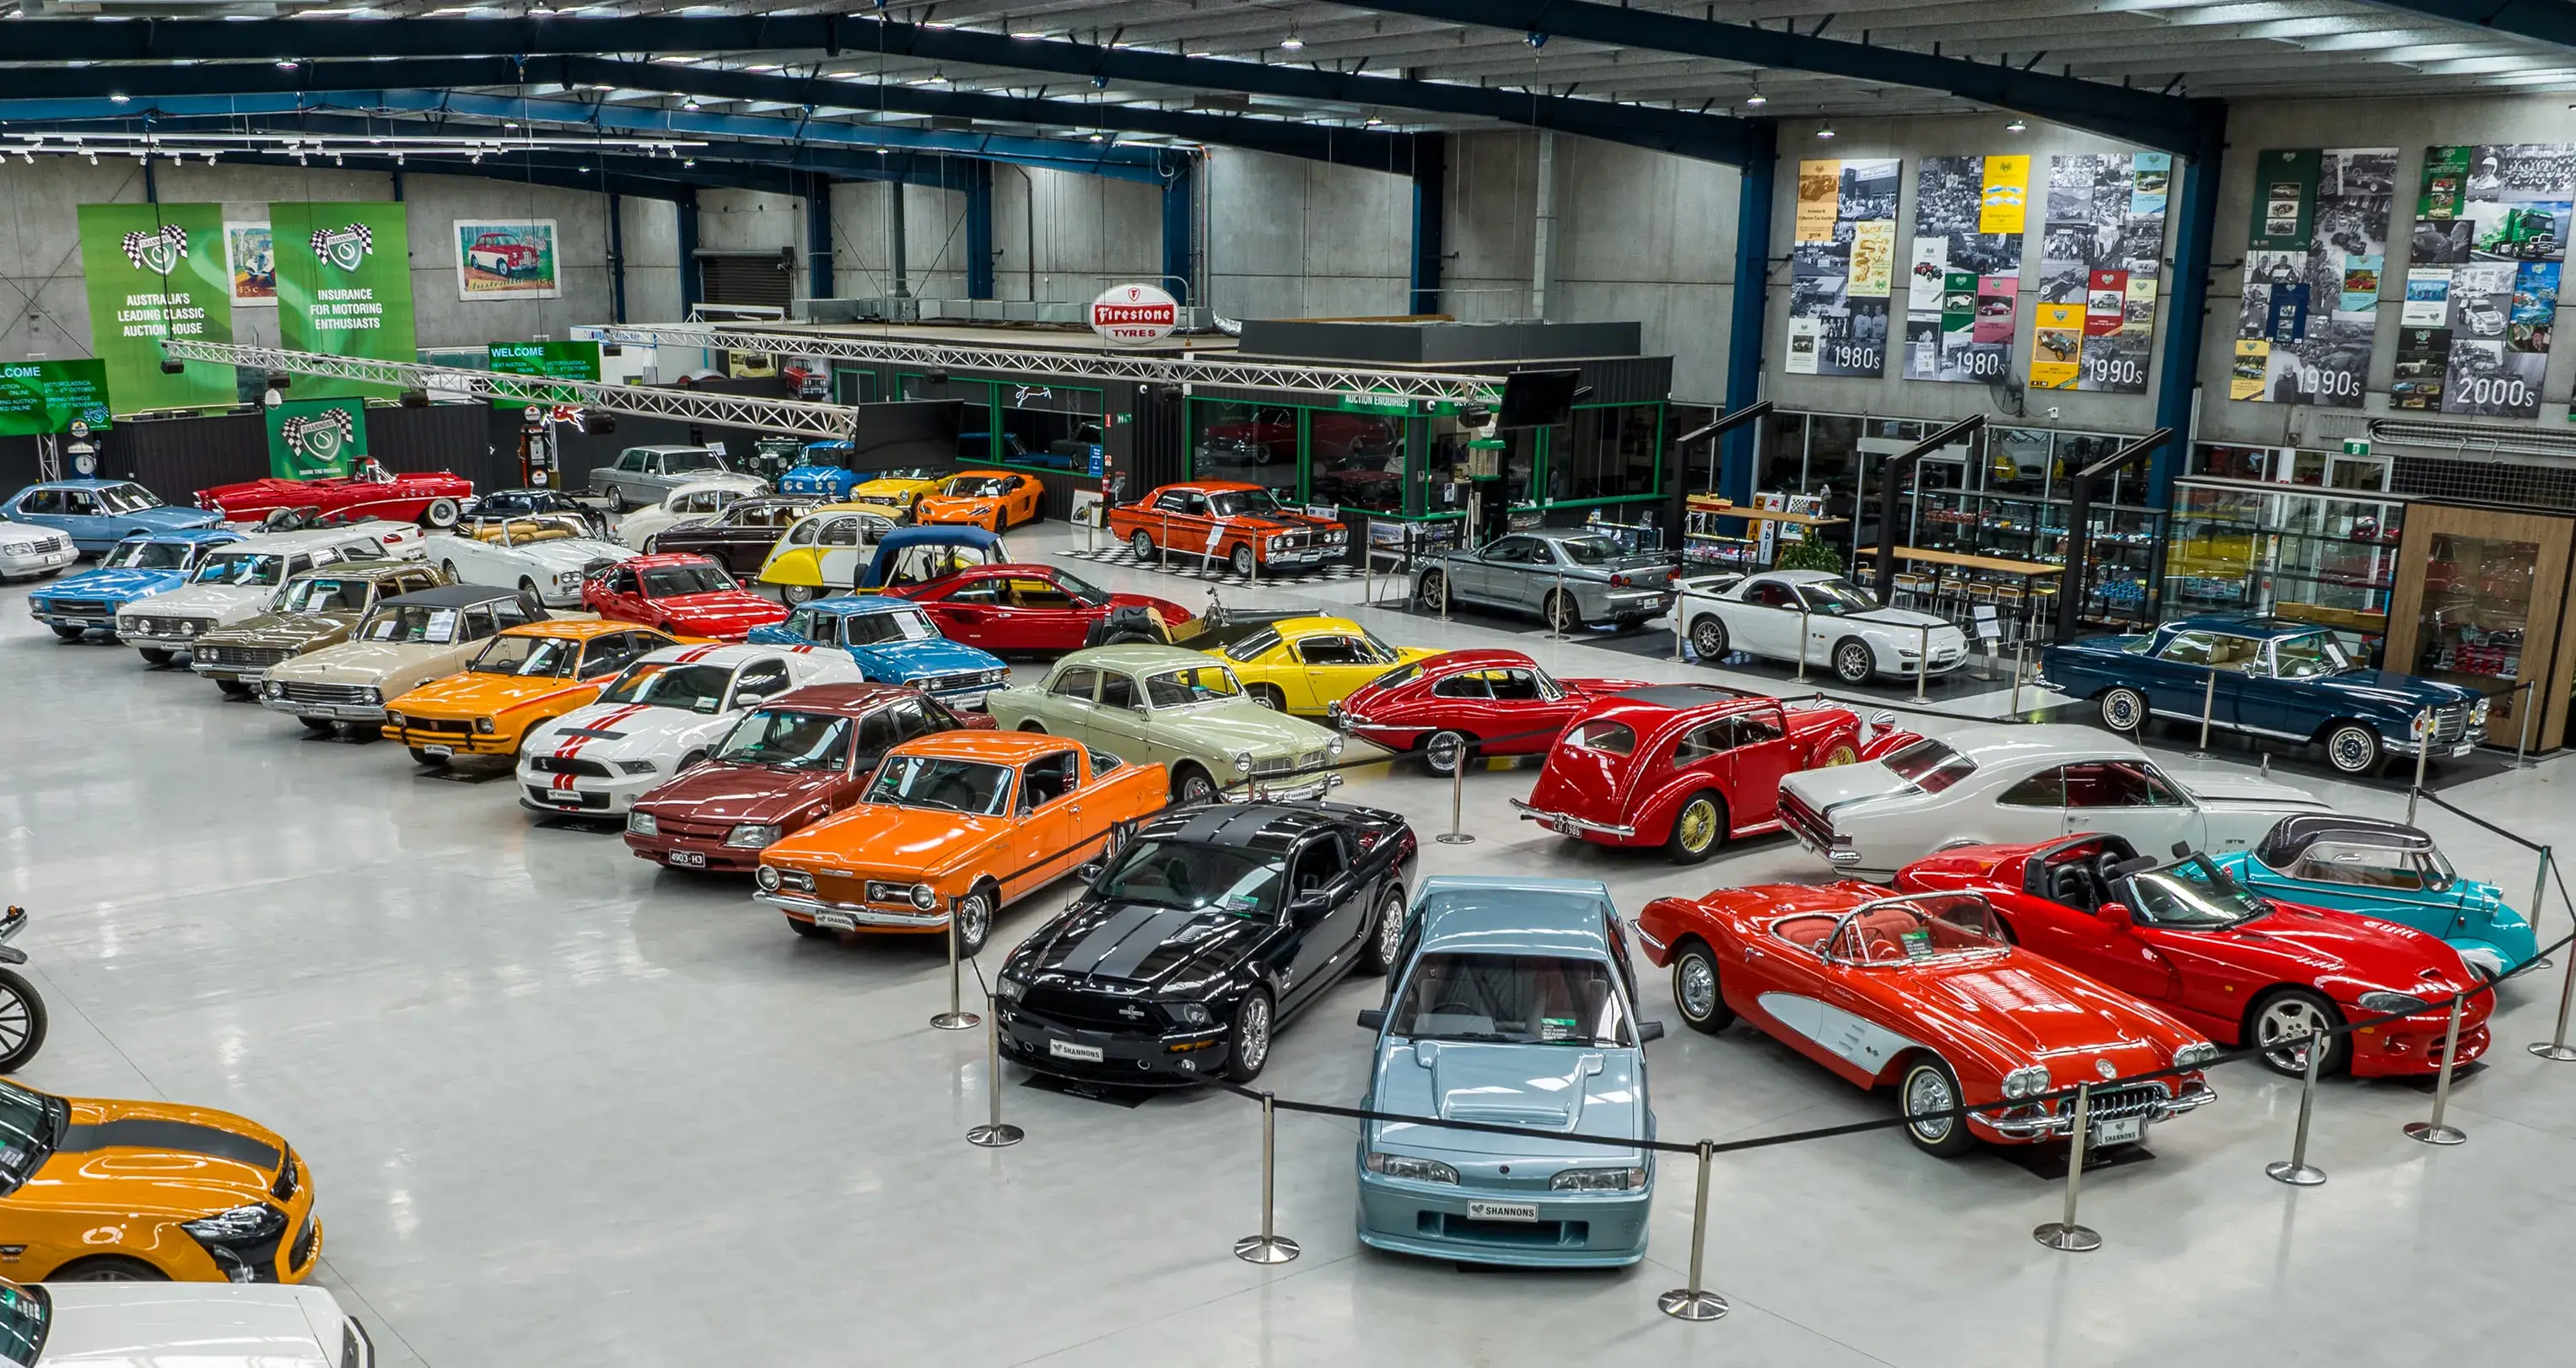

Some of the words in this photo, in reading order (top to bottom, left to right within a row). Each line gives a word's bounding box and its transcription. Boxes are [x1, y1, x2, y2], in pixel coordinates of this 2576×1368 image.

[141, 236, 170, 247] SHANNNS
[127, 293, 190, 306] AUSTRALIA'S
[318, 288, 372, 300] INSURANCE
[118, 309, 161, 322] LEADING
[164, 307, 204, 320] CLASSIC
[310, 304, 330, 315] FOR
[332, 303, 382, 315] MOTORING
[1097, 307, 1171, 323] Firestone
[315, 317, 380, 330] ENTHUSIASTS
[124, 324, 166, 337] AUCTION
[1113, 329, 1156, 337] TYRES
[491, 347, 545, 358] WELCOME
[1835, 345, 1880, 369] 1980s
[0, 366, 40, 378] COME
[2088, 359, 2142, 385] 1990s
[2300, 369, 2360, 396] 1990s
[2456, 377, 2535, 407] 2000s
[1345, 394, 1372, 405] AUCTION
[1374, 395, 1409, 407] ENQUIRIES
[1064, 1047, 1100, 1058] SHANNONS
[2104, 1132, 2136, 1144] SHANNONS
[1485, 1206, 1534, 1217] SHANNONS
